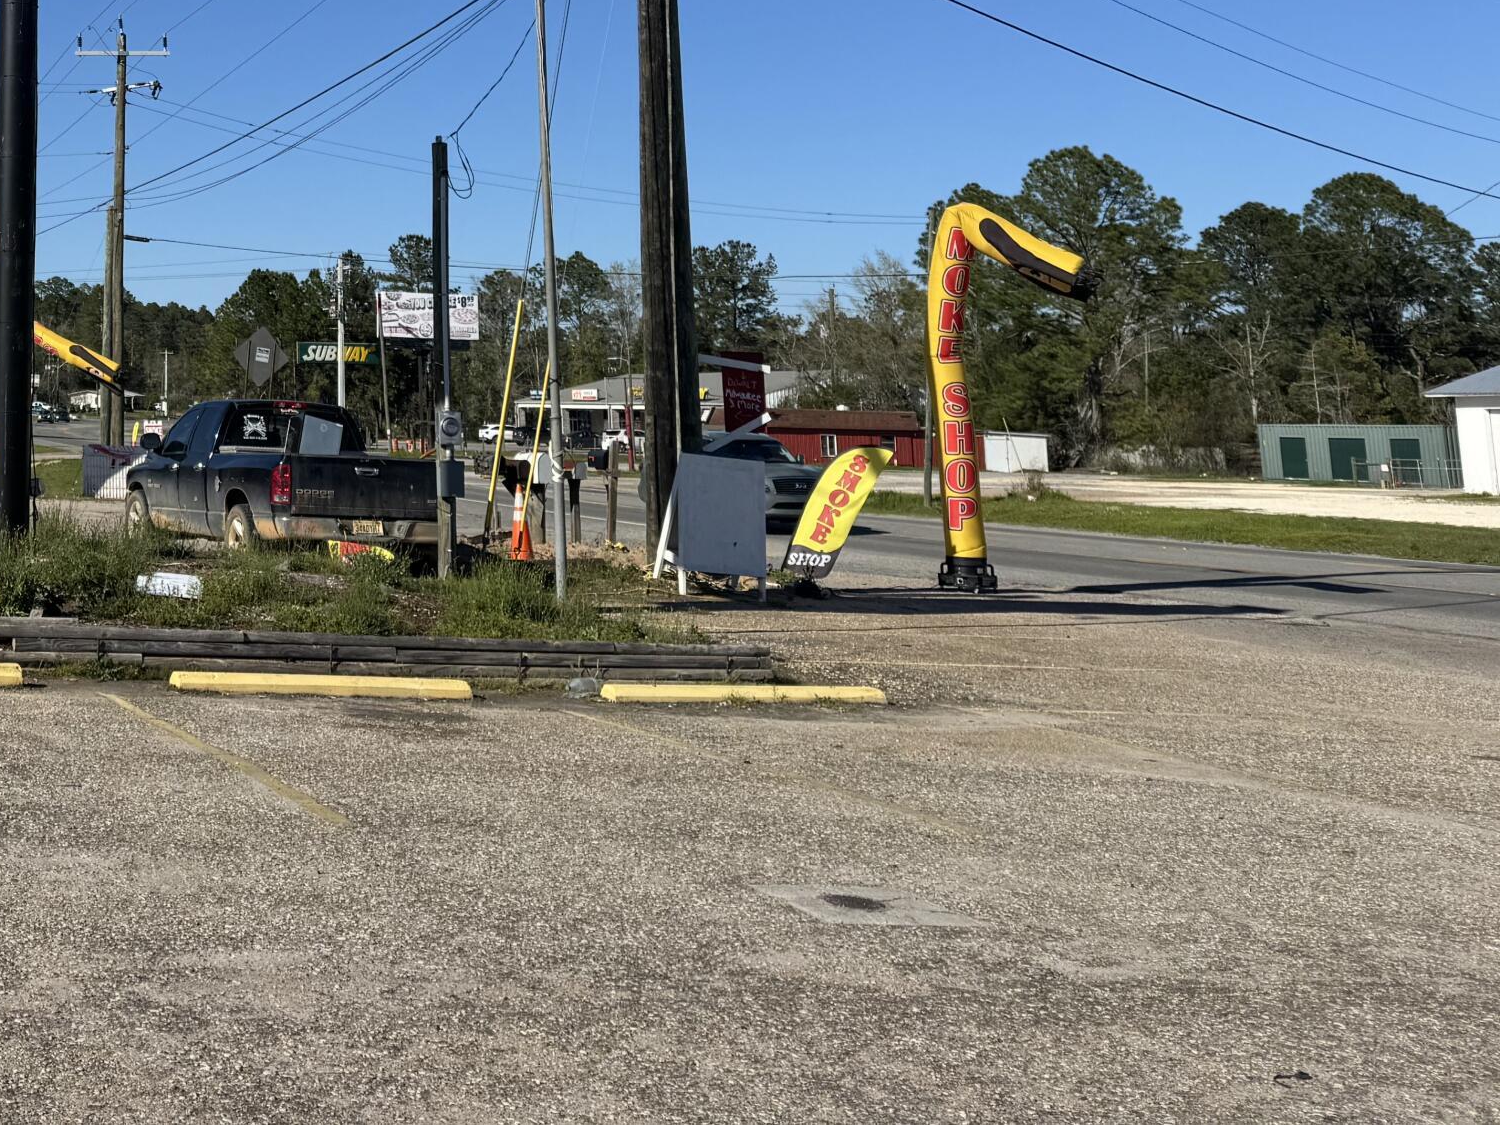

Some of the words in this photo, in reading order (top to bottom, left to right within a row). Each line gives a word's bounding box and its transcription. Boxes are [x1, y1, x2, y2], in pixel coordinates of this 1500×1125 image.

[809, 455, 869, 545] SMOKE
[942, 381, 978, 531] SHOP
[787, 552, 832, 567] SHOP
